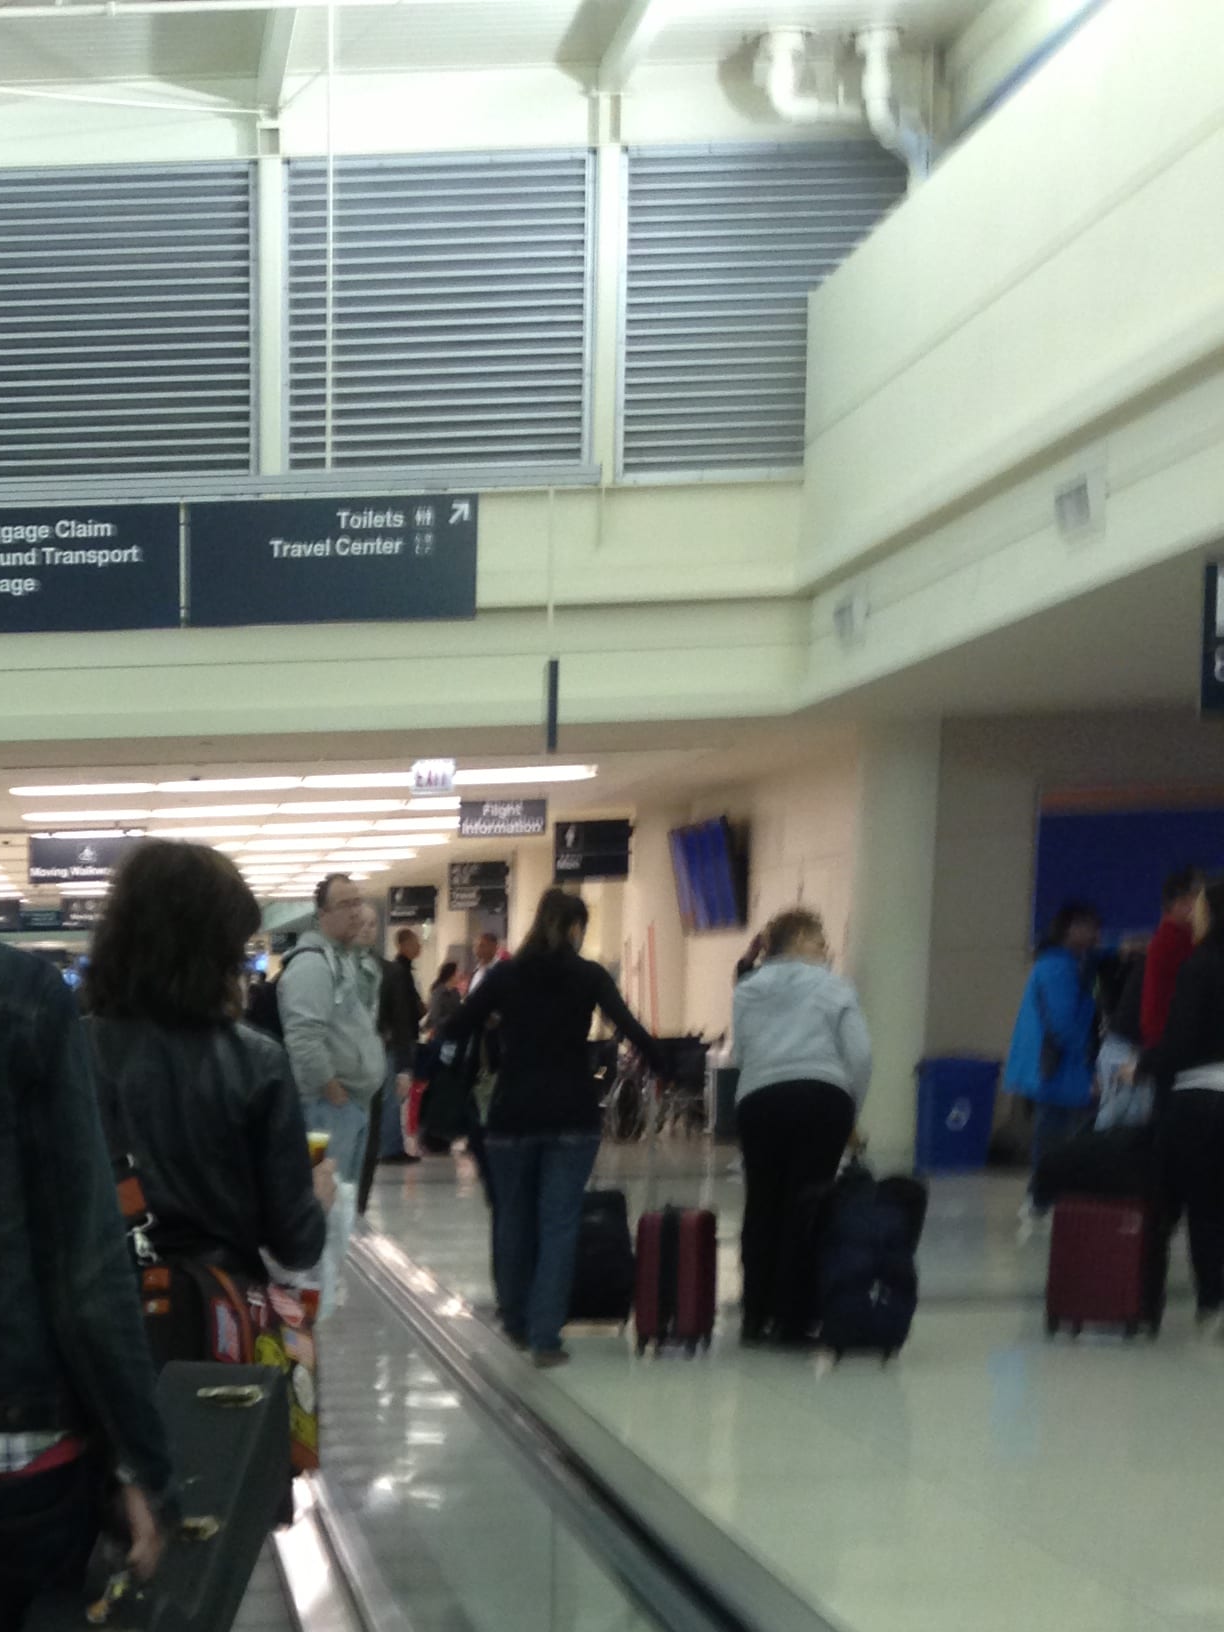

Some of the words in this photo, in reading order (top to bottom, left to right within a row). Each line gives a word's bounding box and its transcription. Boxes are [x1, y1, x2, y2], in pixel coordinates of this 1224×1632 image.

[336, 507, 405, 529] Toilets
[55, 519, 116, 538] Claim
[41, 545, 143, 567] Transport
[269, 538, 330, 558] Travel
[335, 534, 404, 556] Center
[482, 801, 524, 819] Flight
[462, 815, 545, 835] Information
[29, 867, 69, 879] Moving
